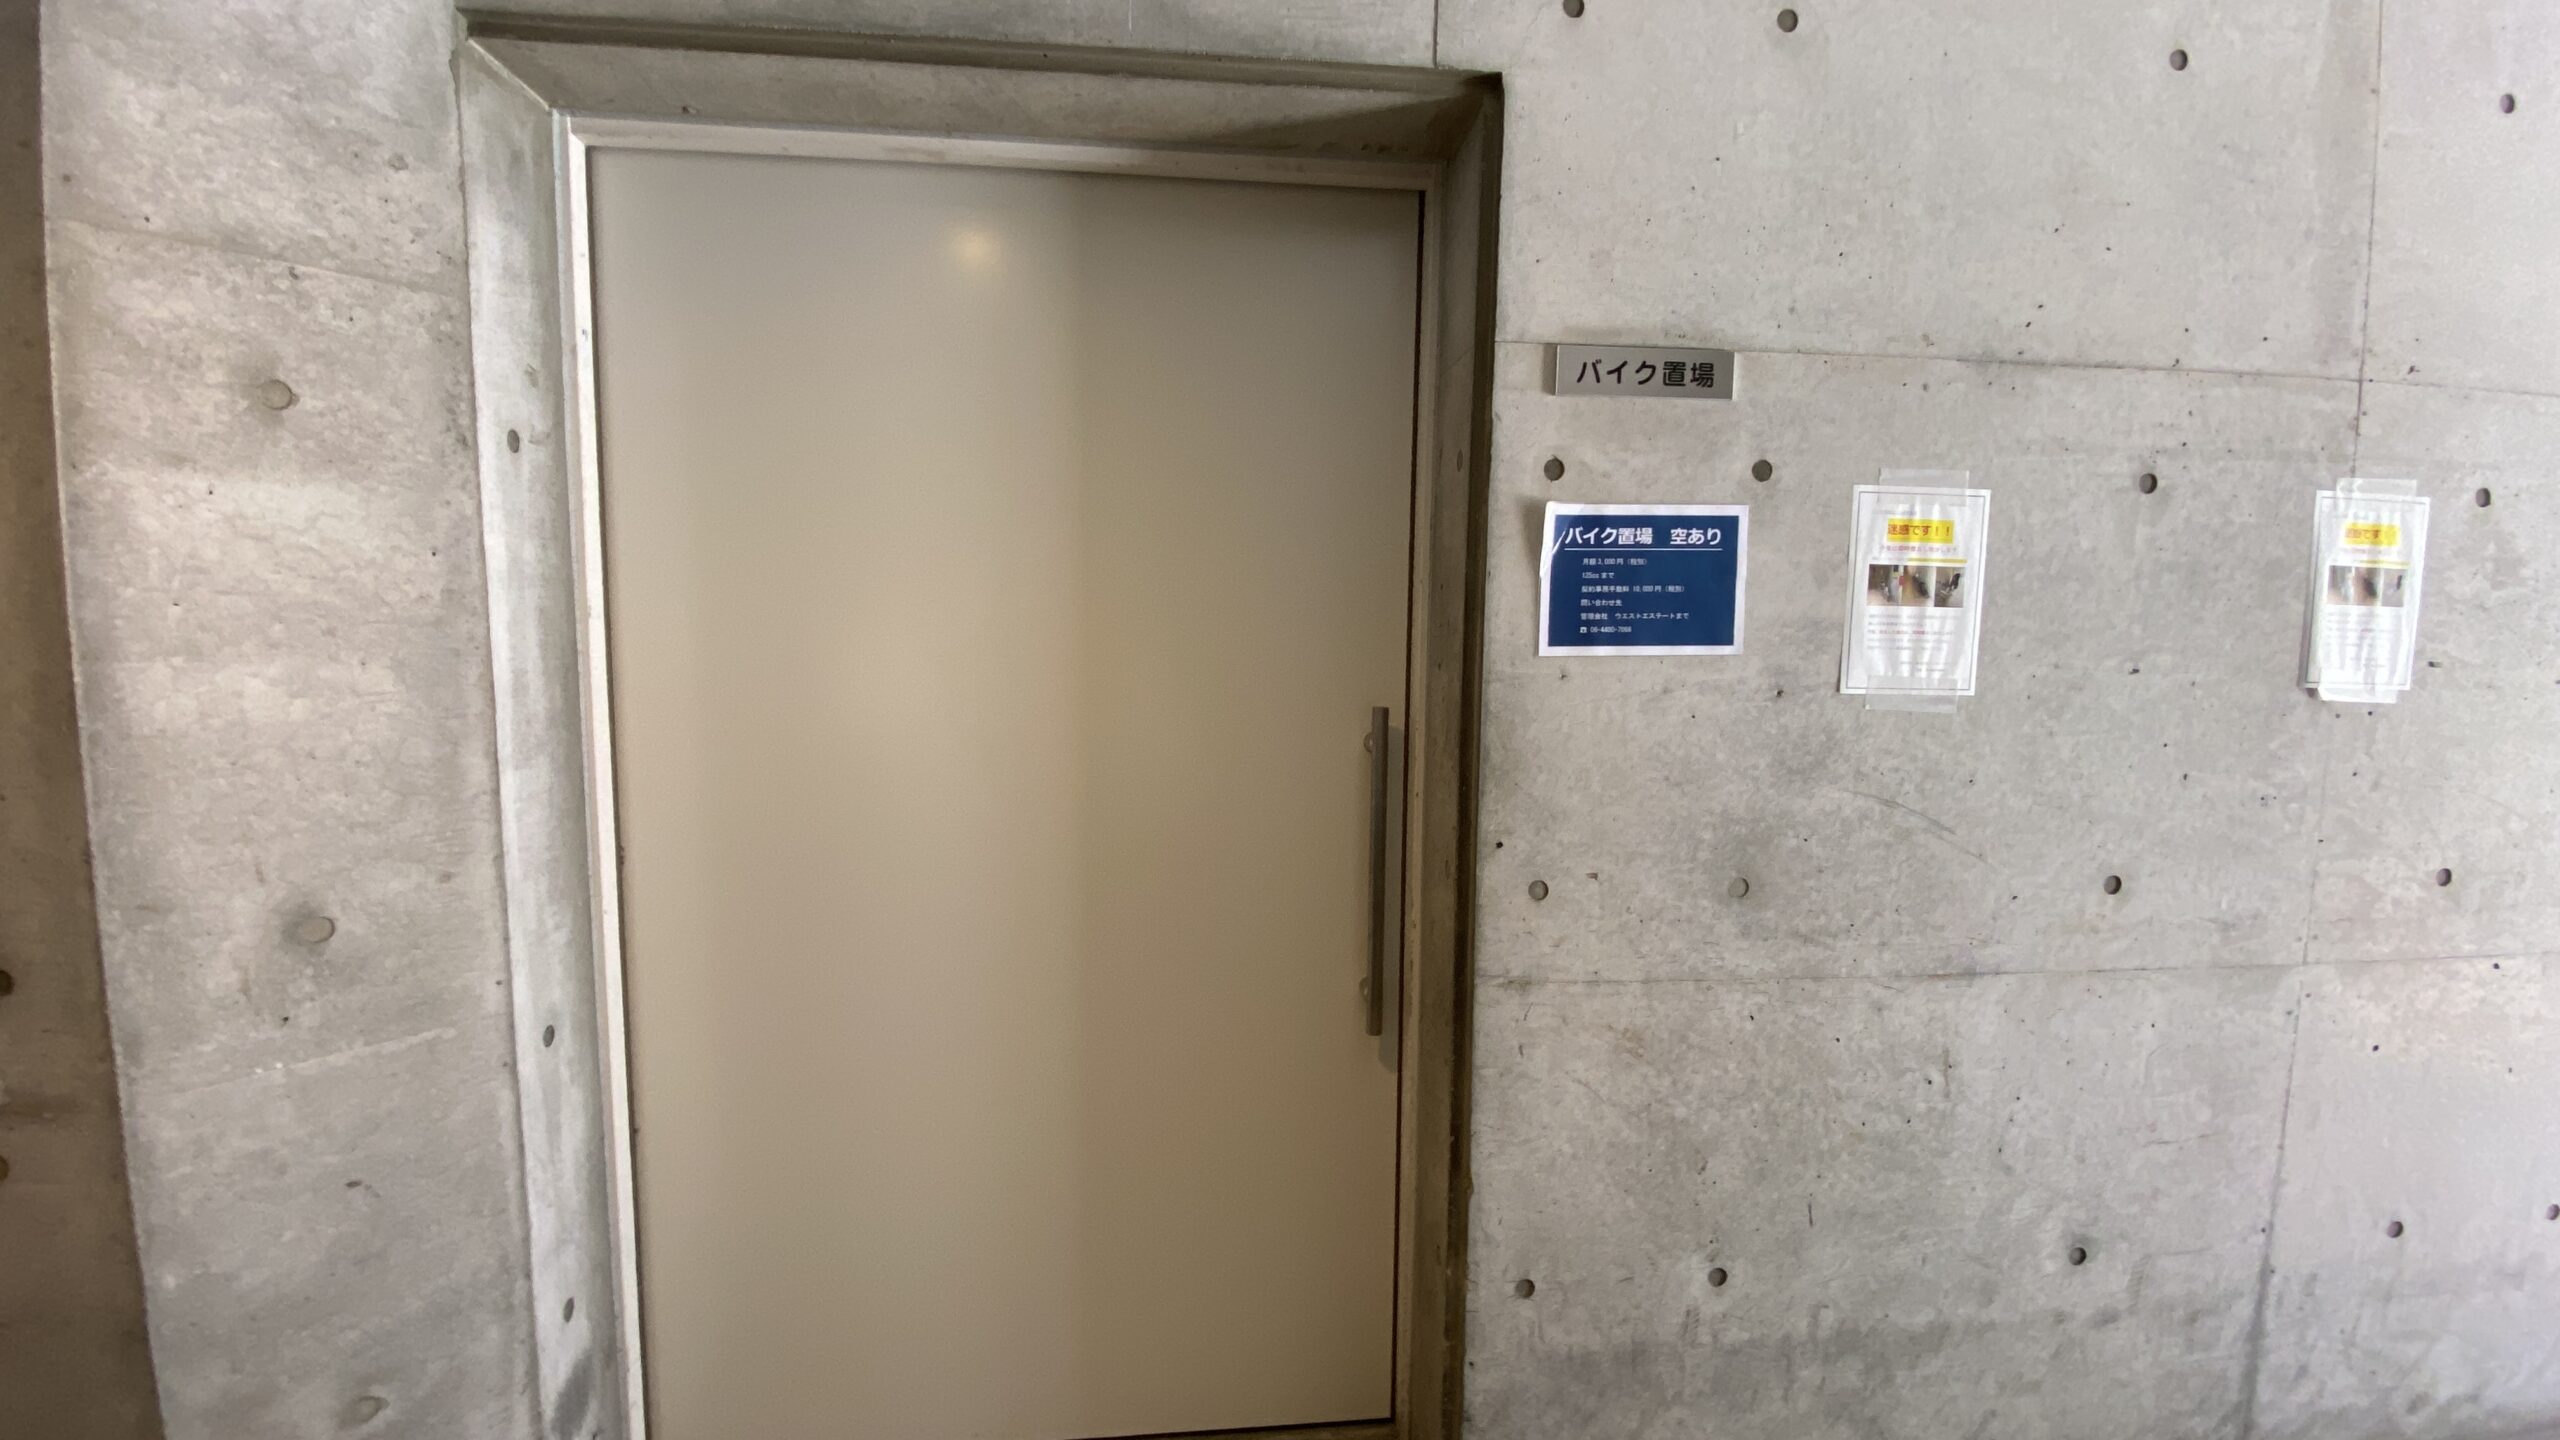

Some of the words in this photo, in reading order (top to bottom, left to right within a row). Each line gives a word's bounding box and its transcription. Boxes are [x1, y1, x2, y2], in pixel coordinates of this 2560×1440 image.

[1576, 359, 1715, 388] バイク置場
[1565, 527, 1652, 545] バイク置場
[1670, 528, 1721, 545] 空あり
